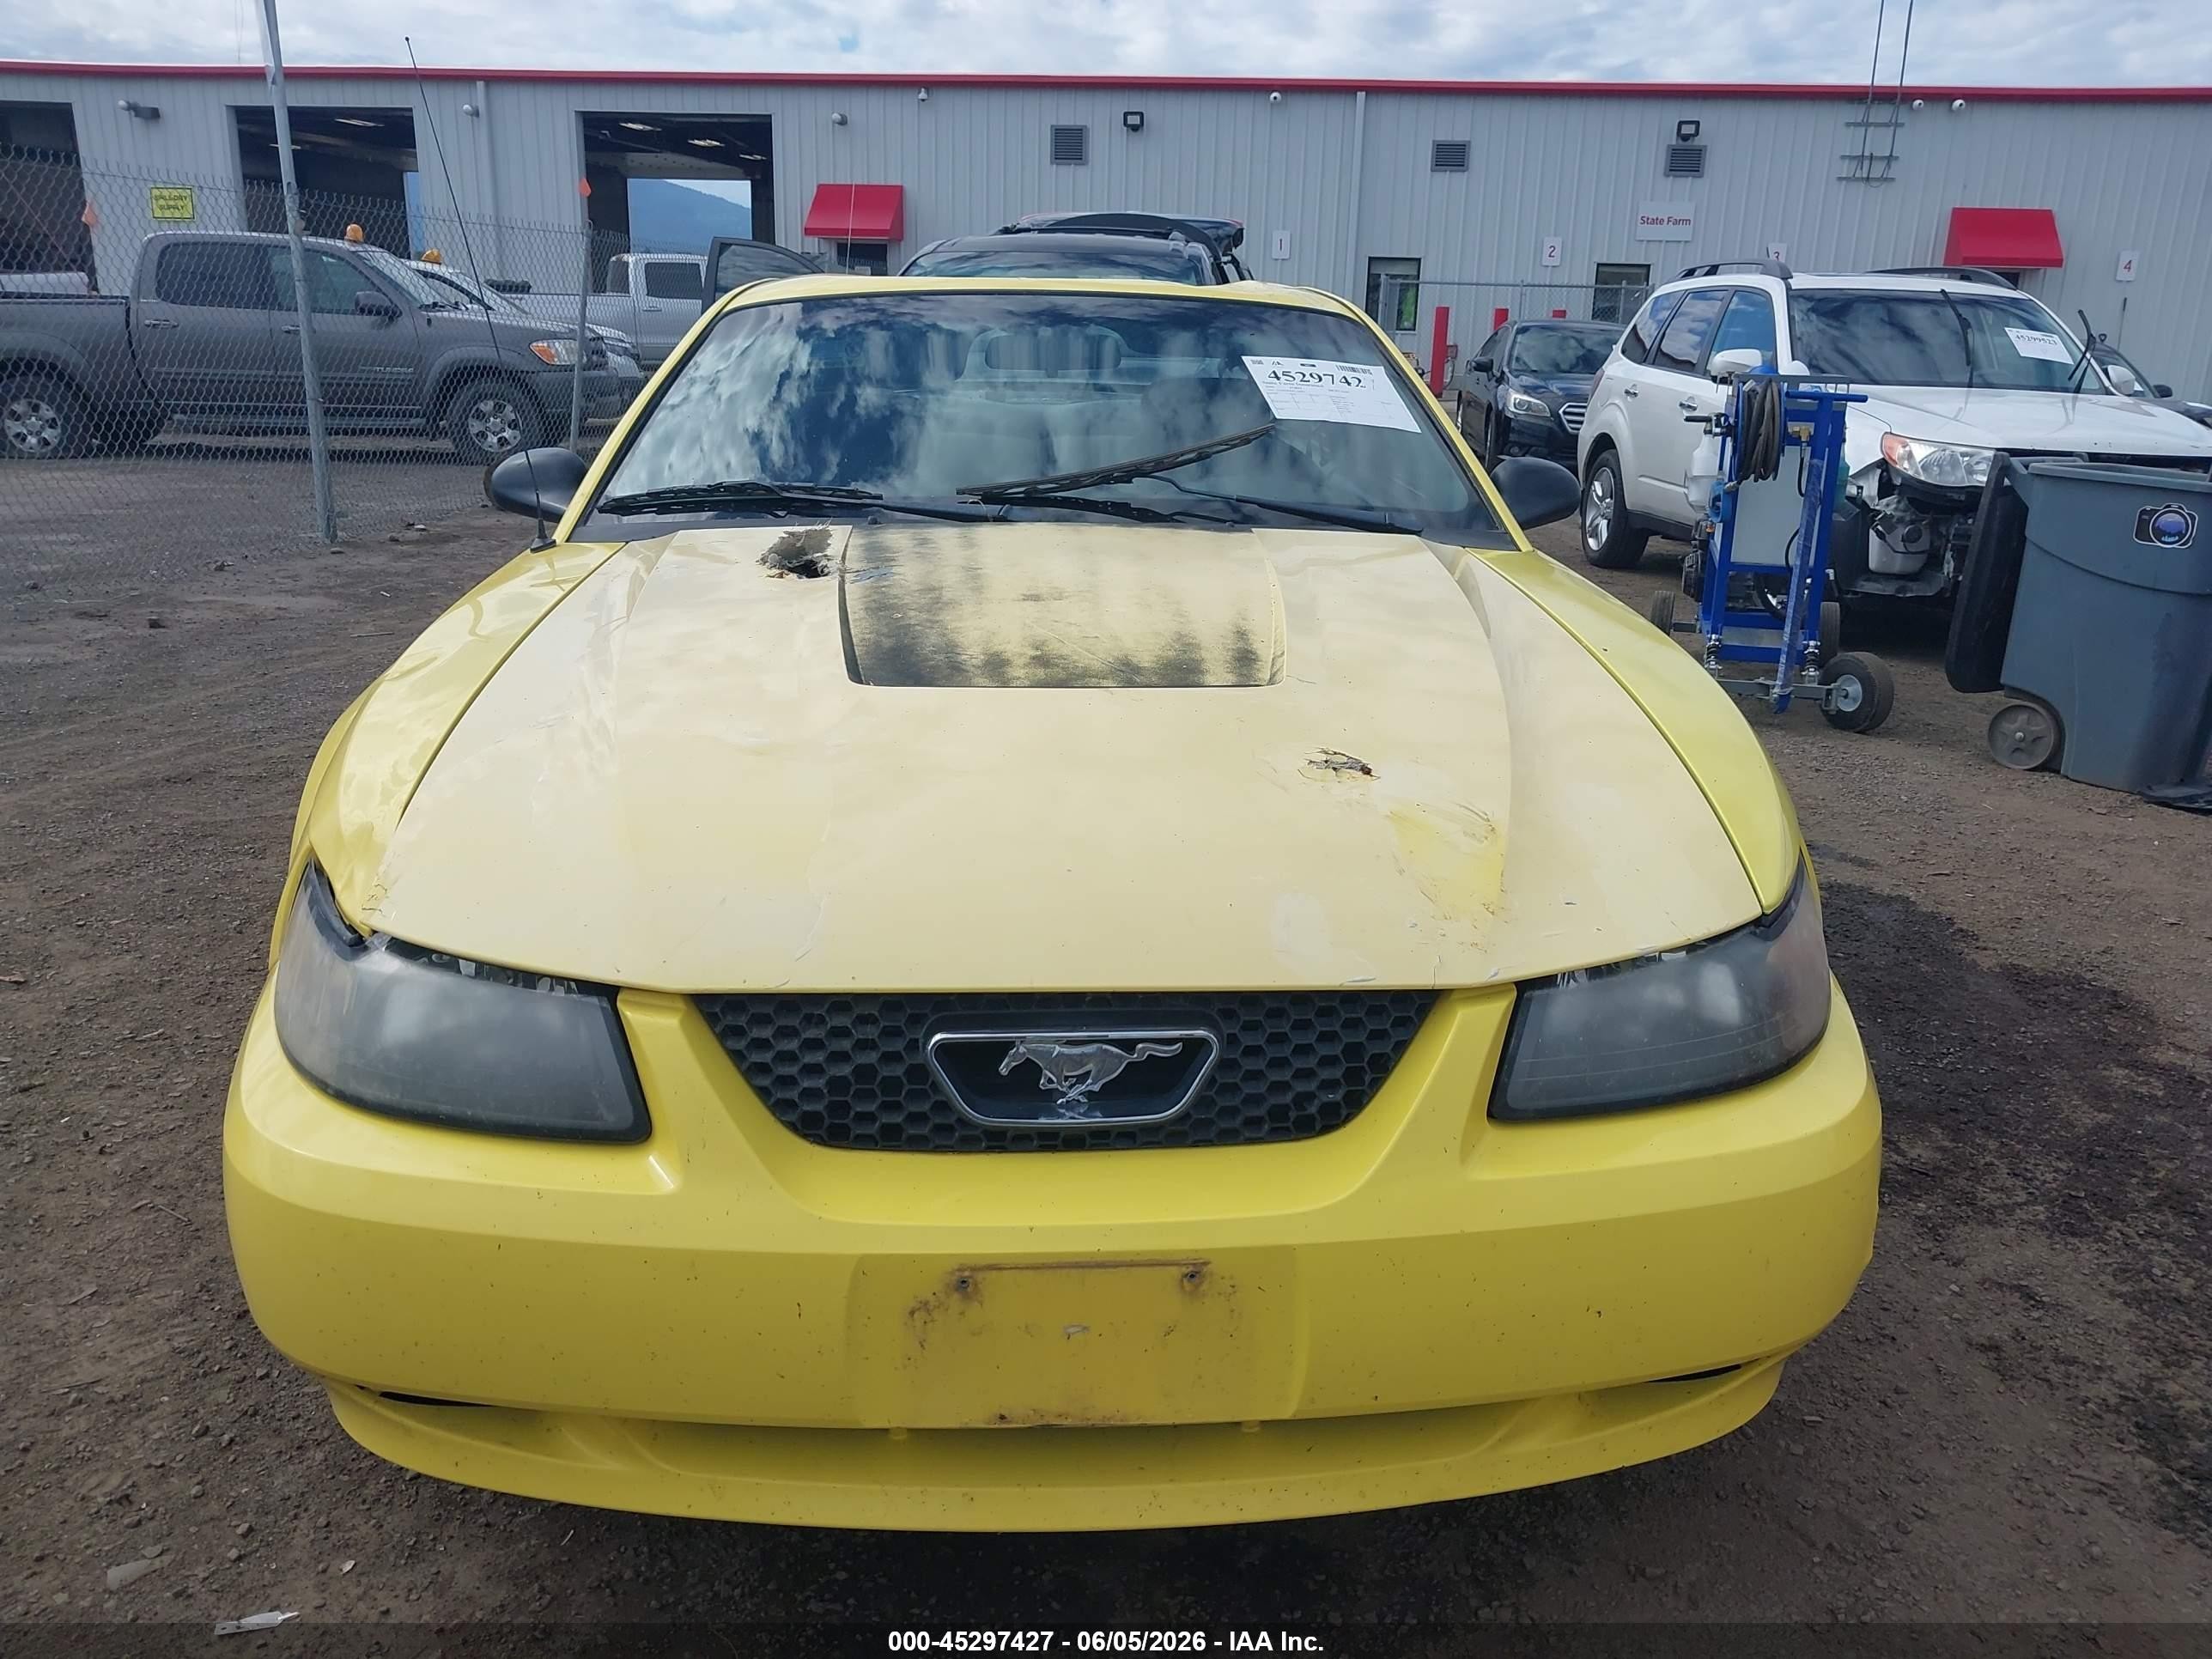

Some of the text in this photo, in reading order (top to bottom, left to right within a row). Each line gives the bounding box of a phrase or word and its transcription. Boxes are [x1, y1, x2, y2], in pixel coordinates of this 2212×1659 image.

[1639, 216, 1692, 226] State Farm
[1548, 245, 1556, 258] 2
[2123, 259, 2133, 273] 4
